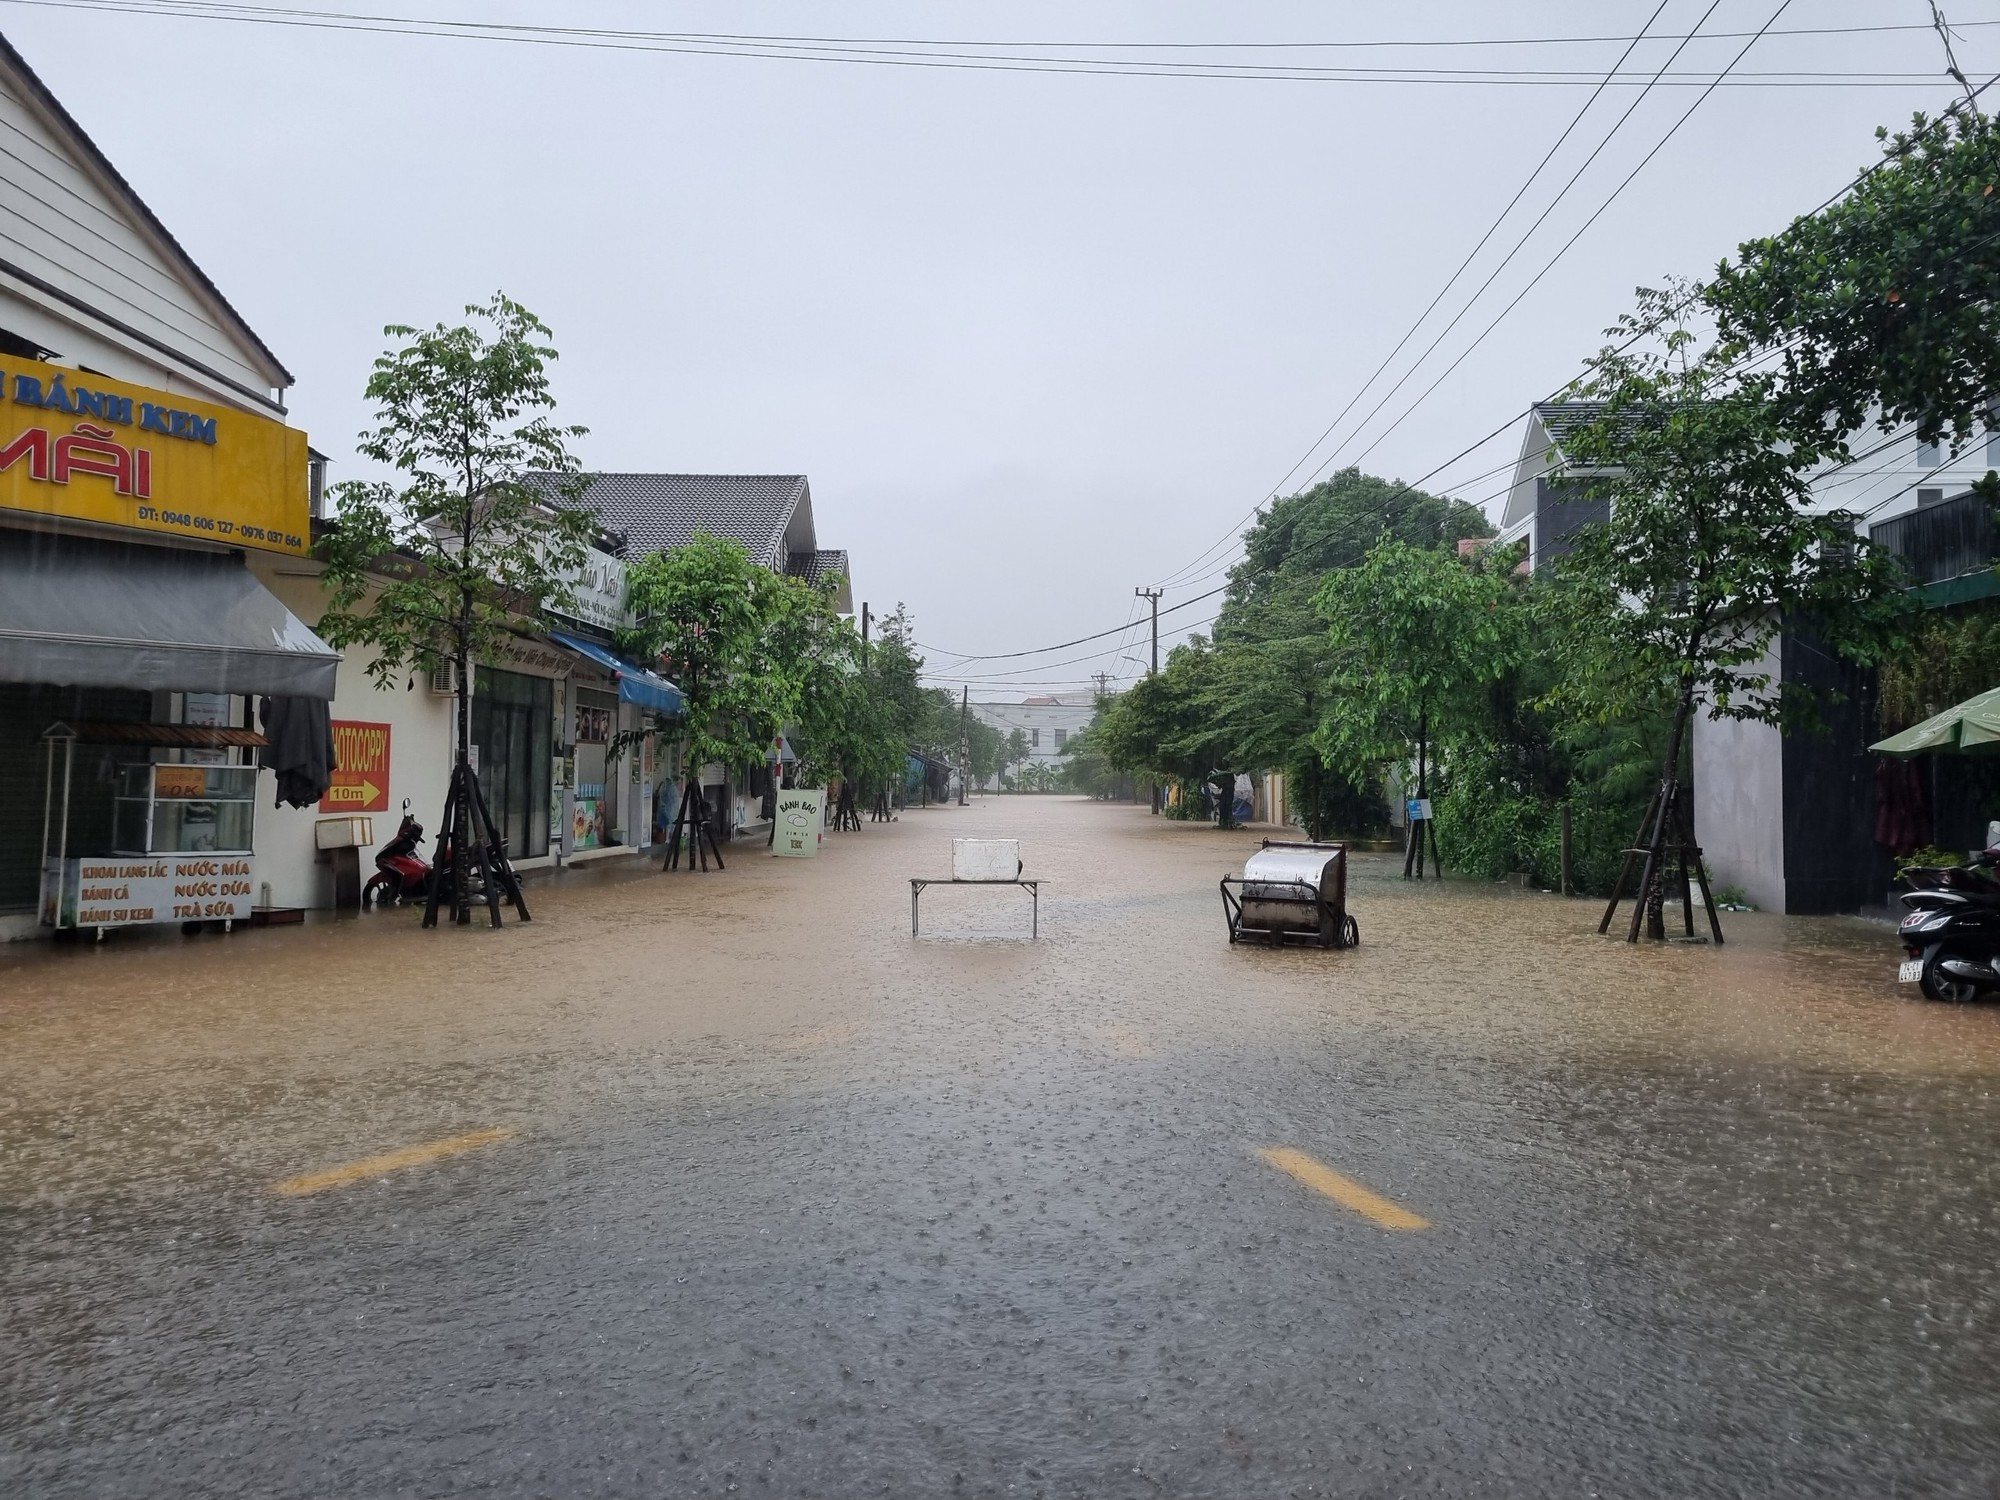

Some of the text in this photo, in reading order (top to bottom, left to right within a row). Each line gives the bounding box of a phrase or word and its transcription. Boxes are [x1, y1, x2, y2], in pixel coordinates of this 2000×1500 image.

[15, 374, 133, 425] BÁNH
[139, 402, 218, 446] KEM
[138, 506, 158, 521] ĐT:
[162, 511, 191, 526] 0948
[194, 518, 214, 530] 606
[267, 530, 283, 544] 037
[286, 535, 302, 548] 664
[331, 726, 388, 772] HOTOCOPPY
[333, 788, 363, 800] 10m
[801, 801, 817, 815] BAO
[82, 866, 117, 879] KHOAI
[119, 865, 147, 878] LANG
[175, 860, 250, 876] NƯỚC MÍA
[81, 884, 129, 901] BÁNH CÁ
[174, 881, 217, 897] NƯỚC
[80, 906, 154, 923] BÁNH SU KEM
[173, 901, 235, 918] TRÀ SỮA
